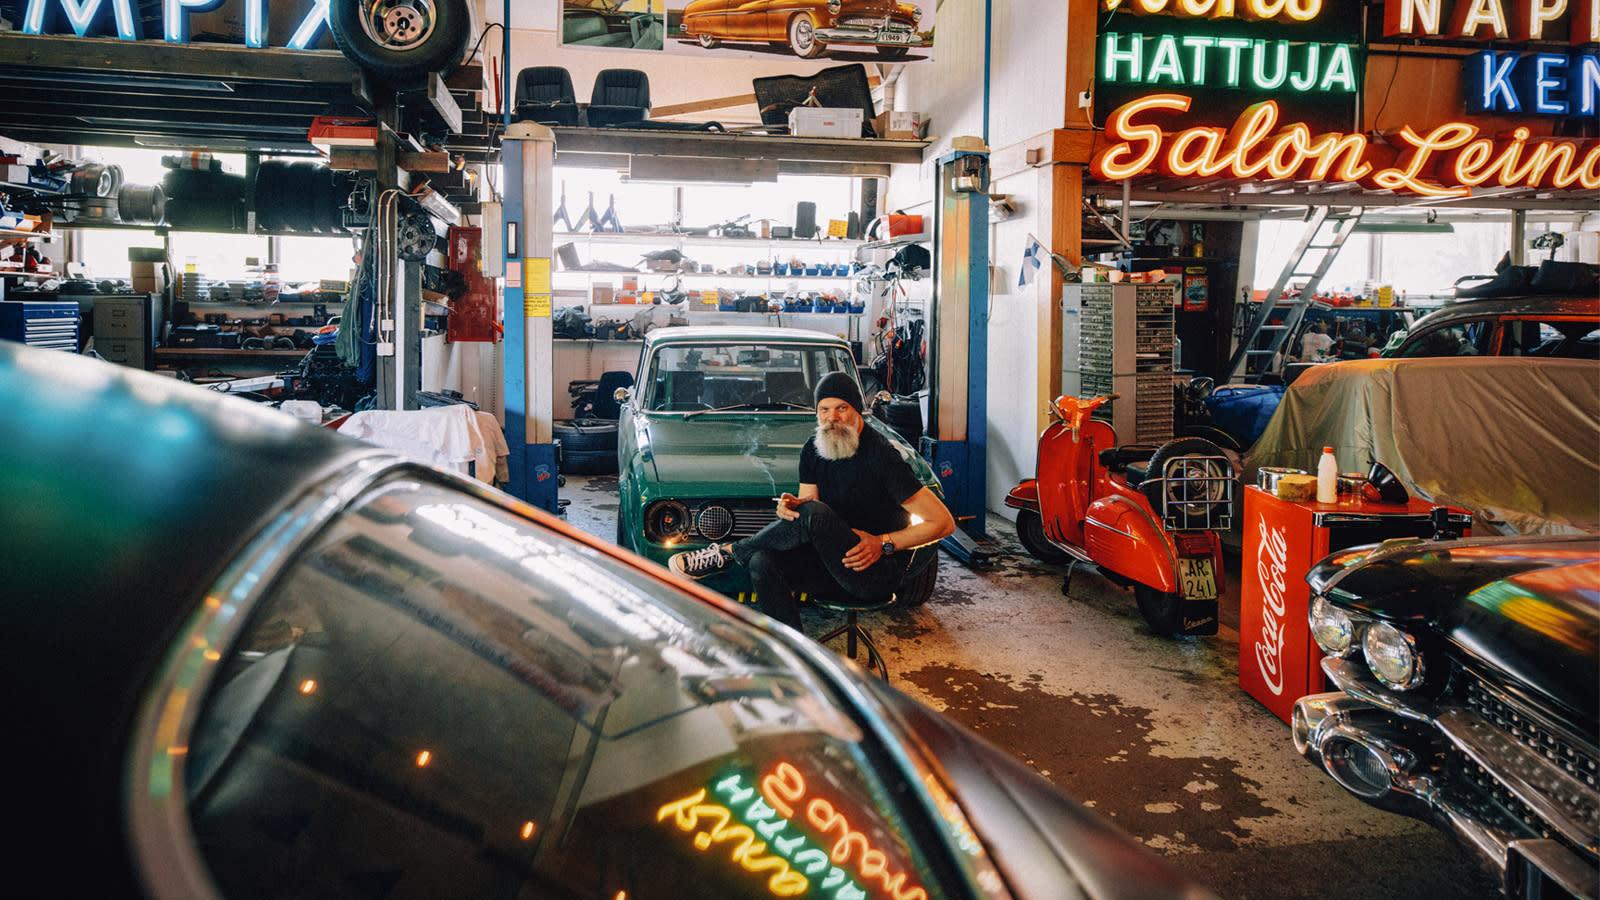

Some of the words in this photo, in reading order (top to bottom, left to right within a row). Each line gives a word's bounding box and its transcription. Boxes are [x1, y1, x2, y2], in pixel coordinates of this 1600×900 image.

[1104, 31, 1357, 93] HATTUJA
[1100, 93, 1373, 181] Salon
[1186, 580, 1212, 598] 241
[1189, 560, 1206, 577] AR
[1255, 512, 1287, 696] Coca-Cola
